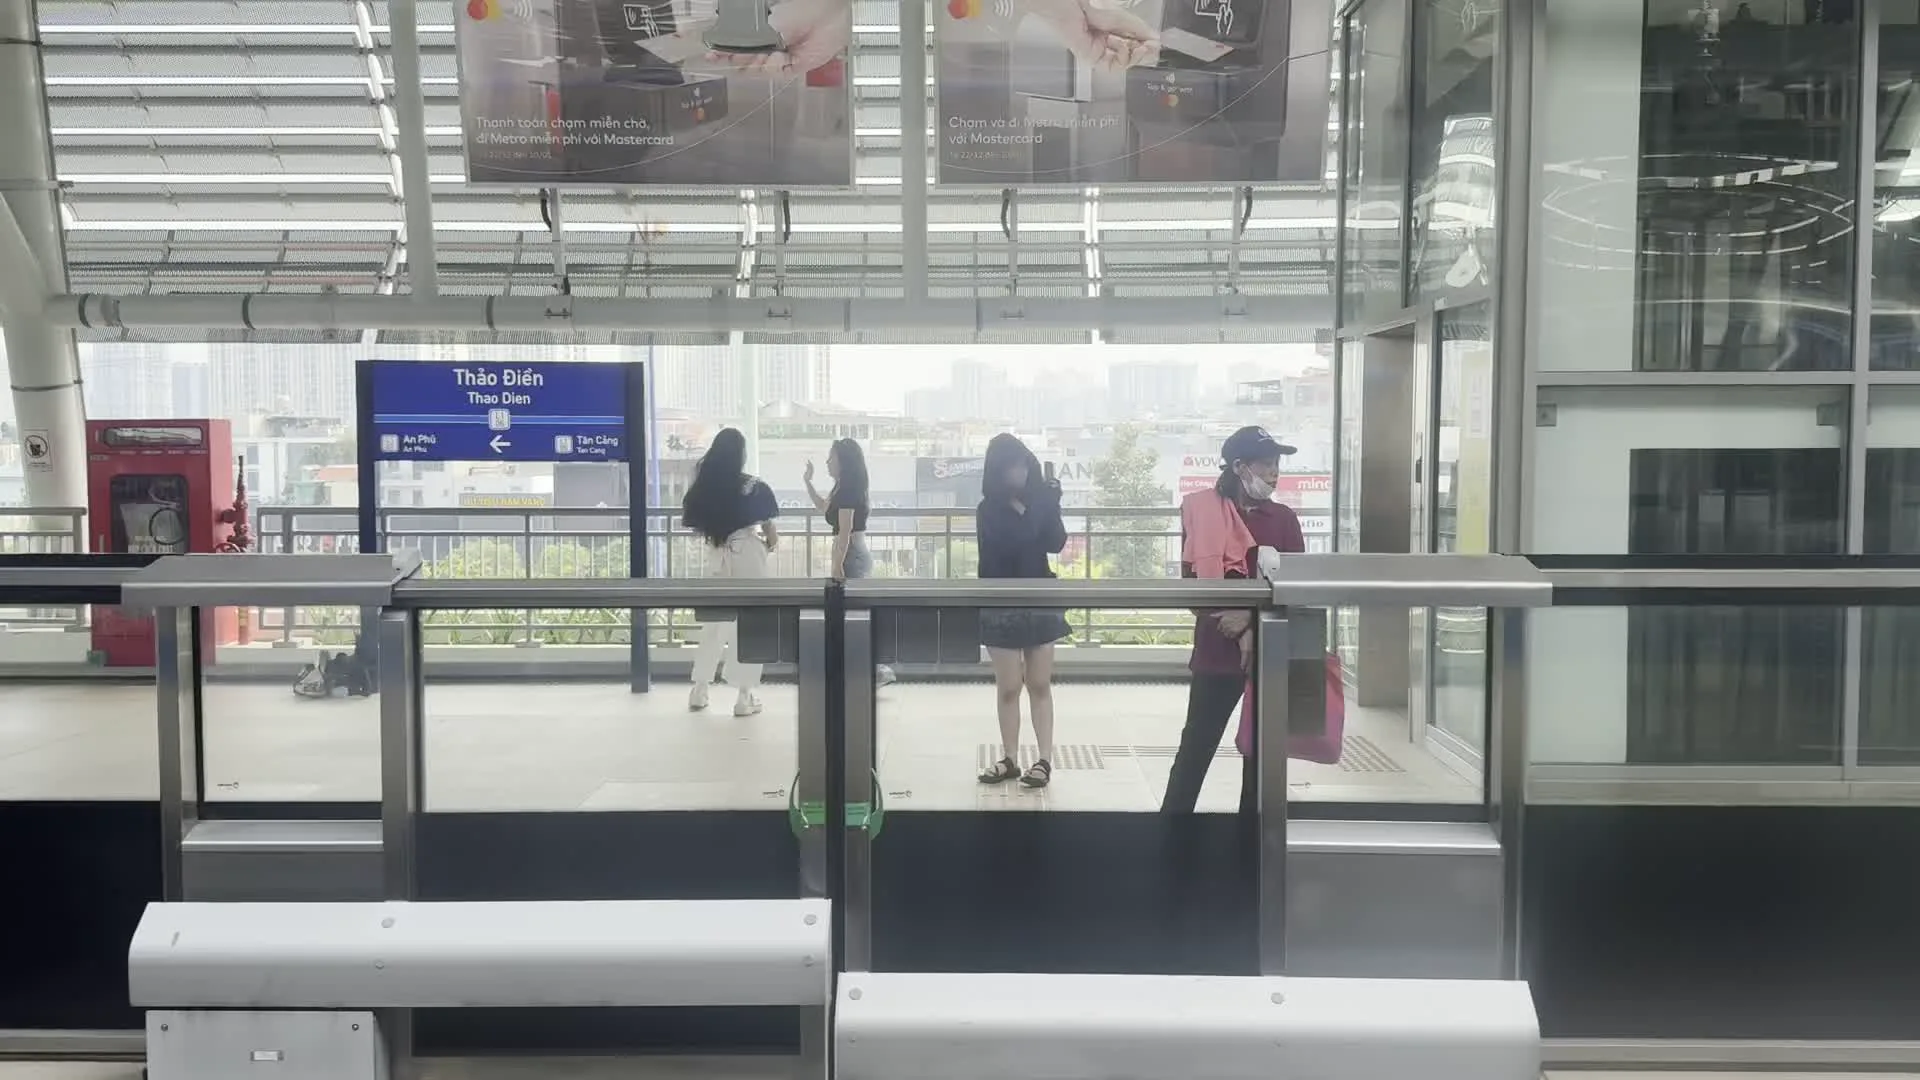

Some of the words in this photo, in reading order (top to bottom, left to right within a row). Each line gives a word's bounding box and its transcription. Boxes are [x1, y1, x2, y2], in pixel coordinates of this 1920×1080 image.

[551, 116, 586, 131] chạm
[490, 132, 527, 144] Metro
[562, 133, 582, 148] phí
[584, 132, 601, 144] với
[604, 133, 674, 145] Mastercard
[970, 132, 1043, 144] Mastercard
[452, 367, 497, 386] Thảo
[502, 367, 543, 386] Điền
[466, 391, 498, 404] Thao
[502, 391, 531, 404] Dien
[403, 435, 416, 444] An
